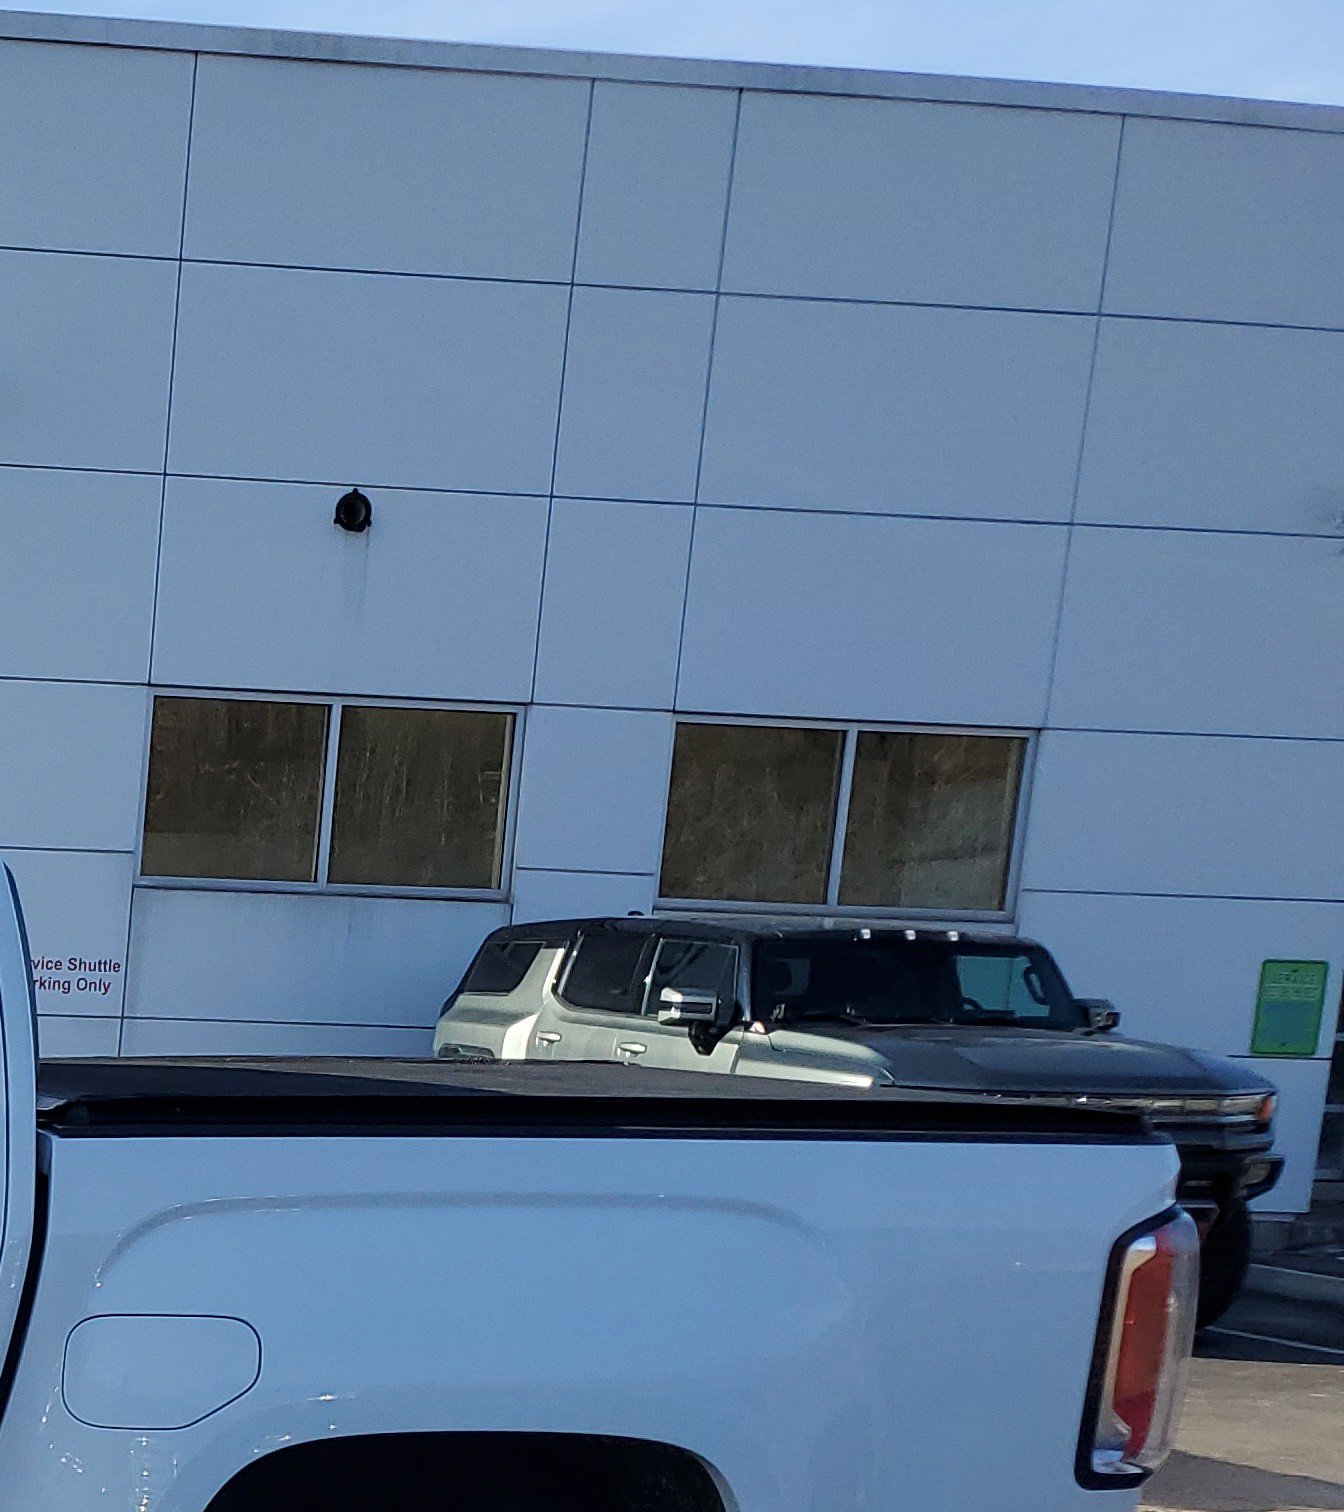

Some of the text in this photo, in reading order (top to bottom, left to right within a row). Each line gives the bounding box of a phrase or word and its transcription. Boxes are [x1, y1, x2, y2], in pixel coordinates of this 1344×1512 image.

[31, 955, 121, 973] vice Shuttle
[33, 976, 112, 996] rking Only
